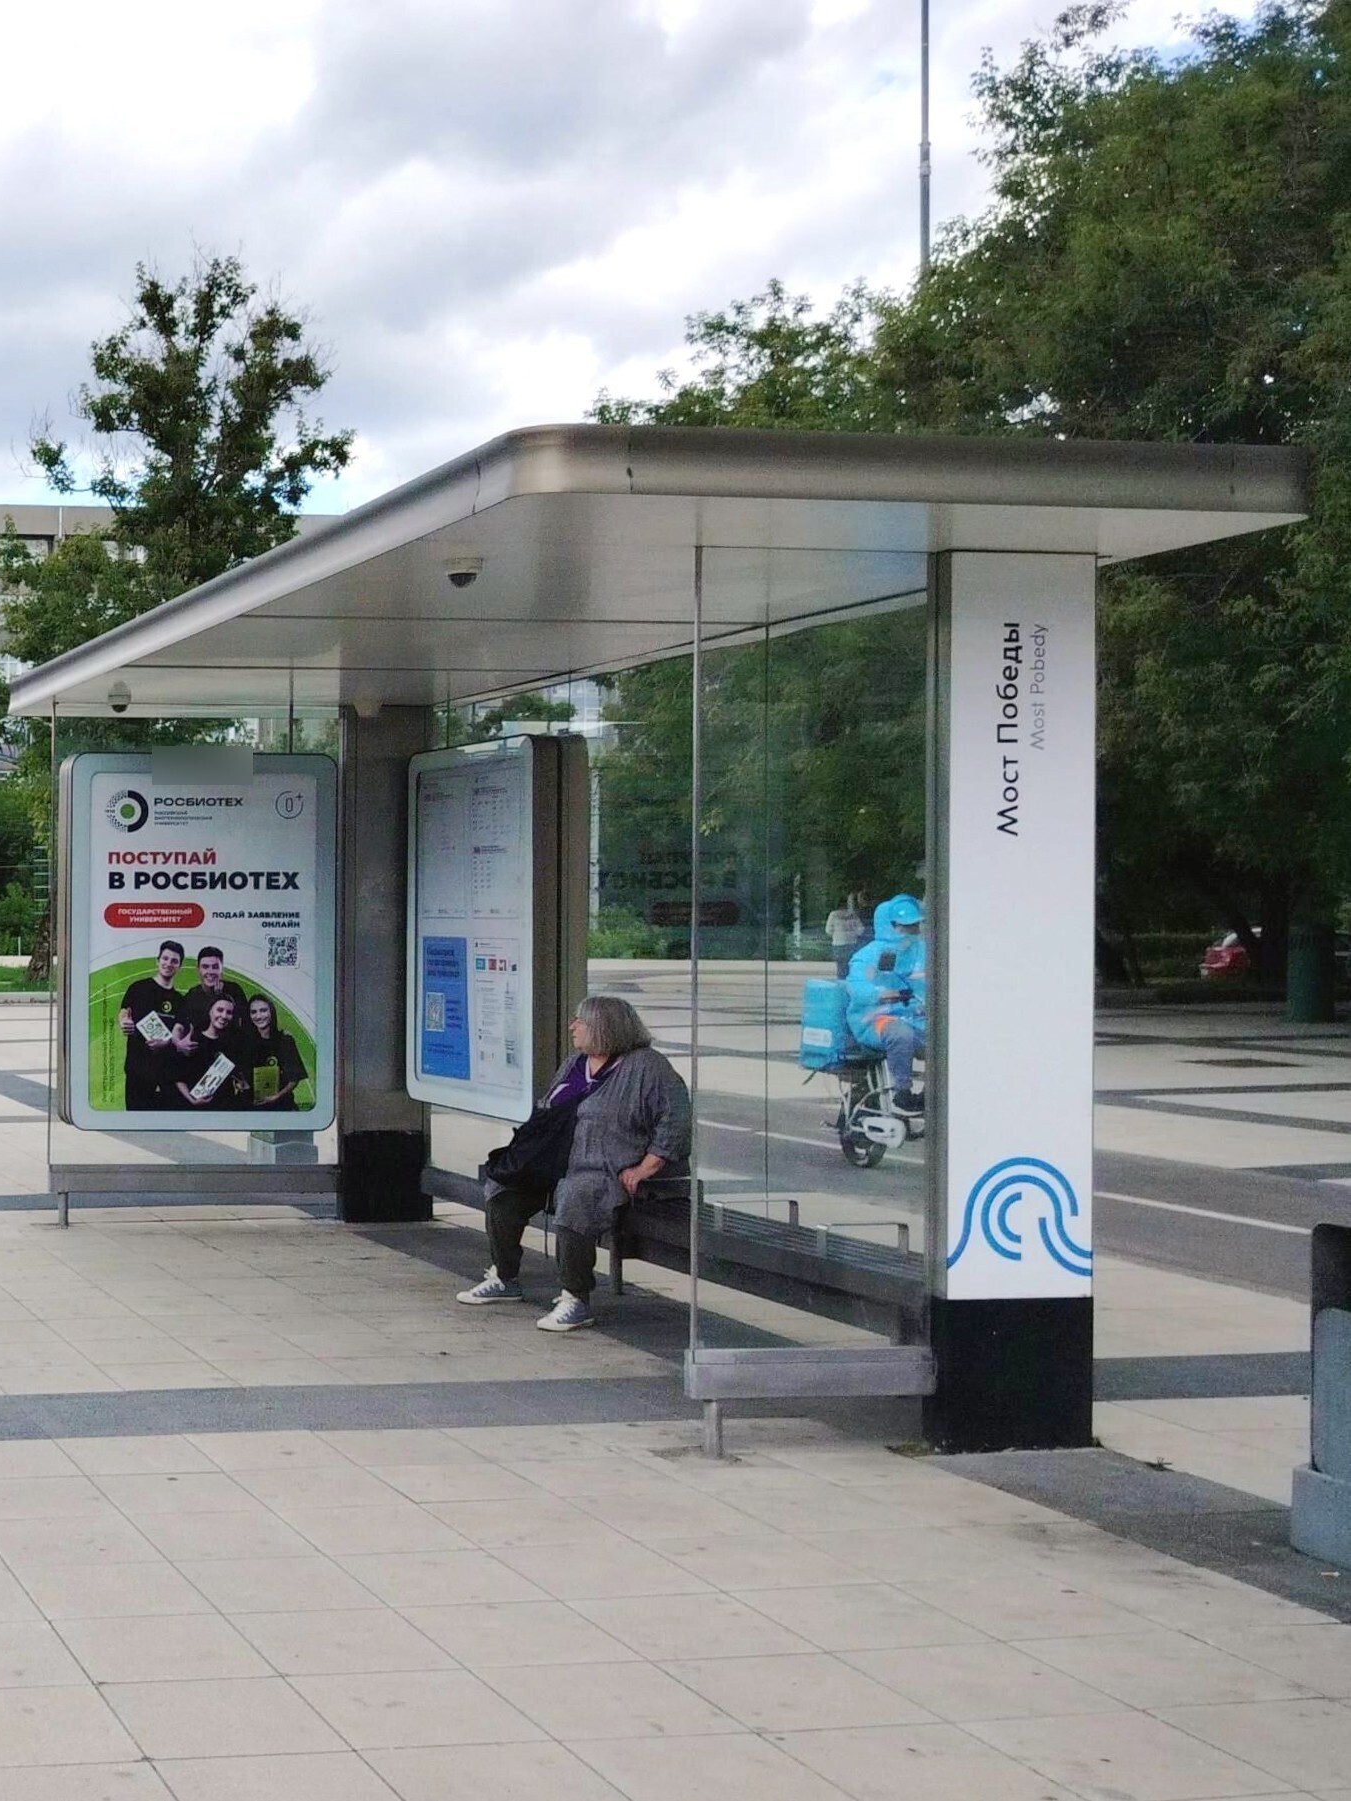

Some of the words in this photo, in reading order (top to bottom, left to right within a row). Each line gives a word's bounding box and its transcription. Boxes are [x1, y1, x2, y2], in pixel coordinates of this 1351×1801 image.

[1029, 624, 1049, 694] Pobedy
[996, 622, 1023, 743] Победы
[1030, 702, 1045, 750] Most
[153, 797, 244, 807] РОСБИОТЕХ
[997, 756, 1019, 836] Мост
[108, 847, 217, 865] ПОСТУПАЙ
[108, 872, 125, 890] В
[134, 871, 300, 890] РОСБИОТЕХ
[117, 907, 193, 916] ГОСУДАРСТВЕННЫЙ
[129, 915, 182, 923] УНИВЕРСИТЕТ
[212, 910, 245, 919] ПОДАЙ
[247, 911, 301, 919] ЗАЯВЛЕНИЕ
[261, 919, 301, 928] ОНЛАЙН
